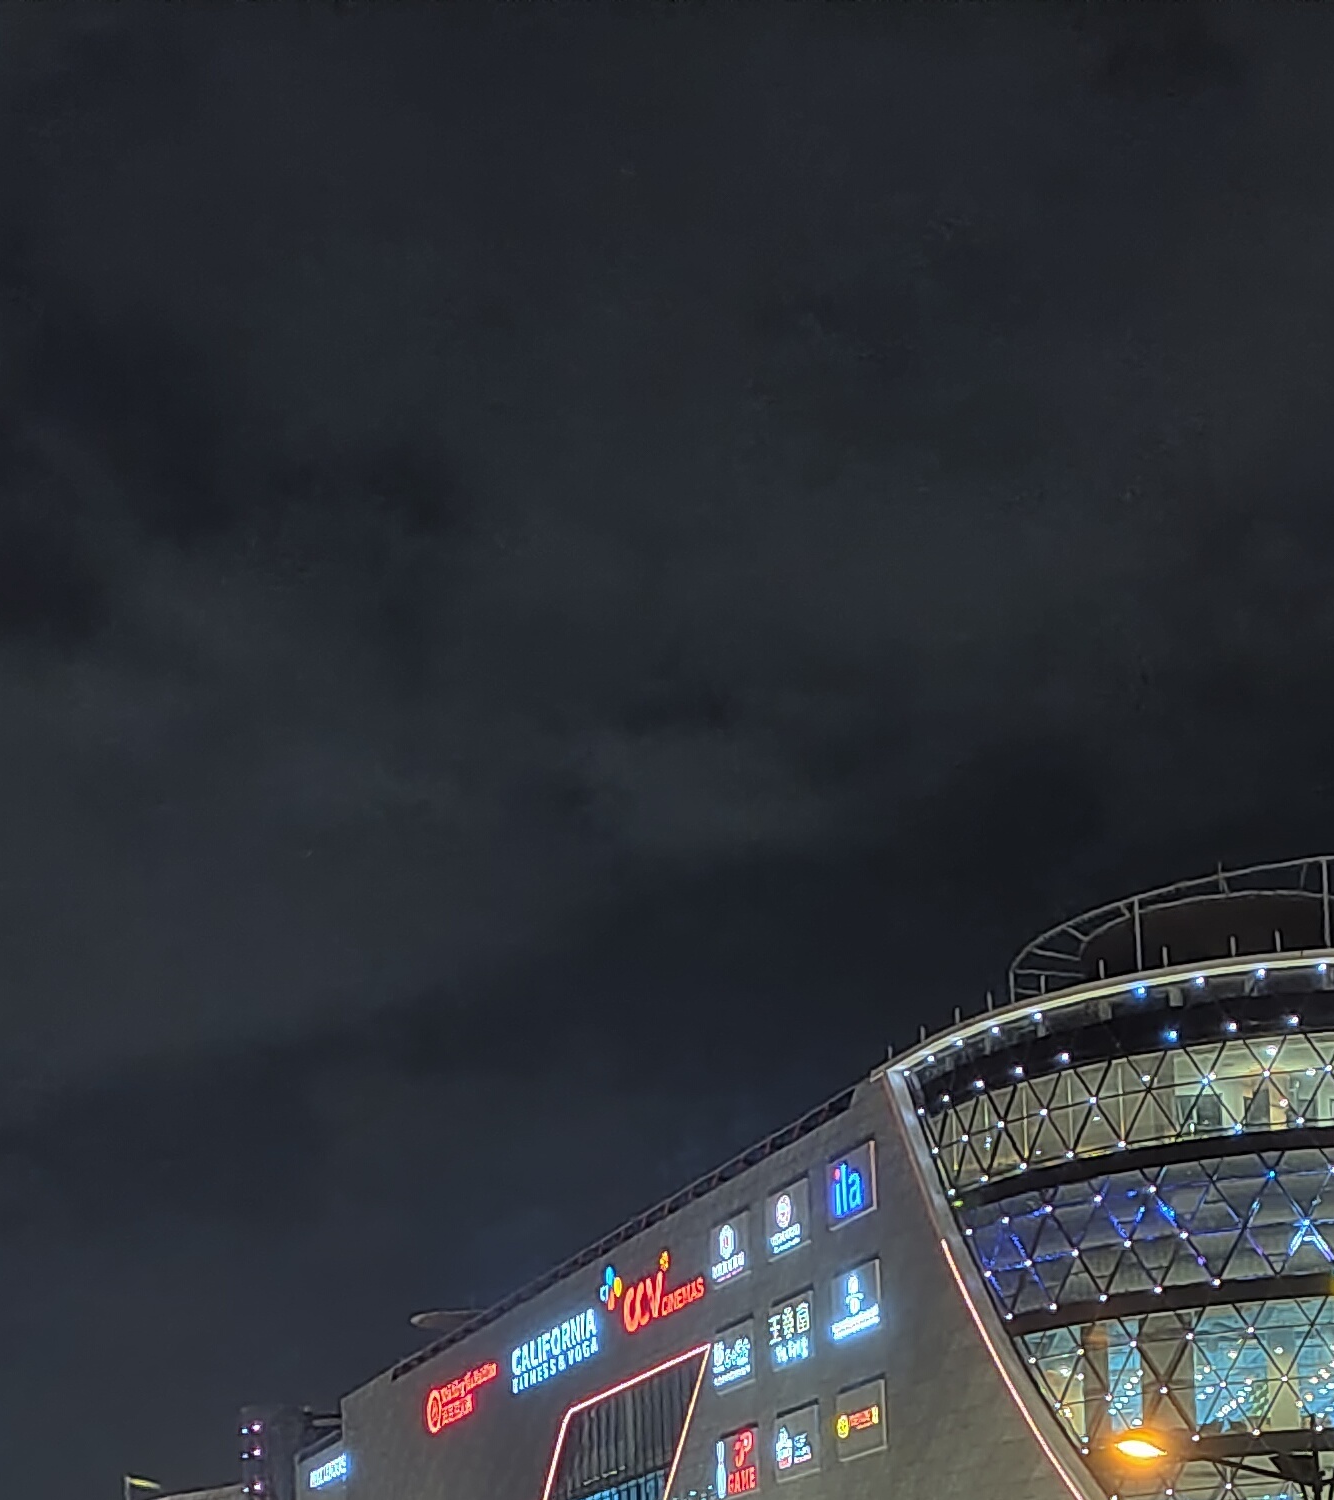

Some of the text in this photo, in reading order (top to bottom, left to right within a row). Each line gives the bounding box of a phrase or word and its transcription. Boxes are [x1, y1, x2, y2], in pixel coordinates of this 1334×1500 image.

[835, 1163, 864, 1216] ila
[661, 1276, 705, 1317] CINEMAS
[511, 1308, 598, 1376] CALIFORNIA
[567, 1336, 599, 1366] YOGA
[727, 1466, 757, 1495] GAME
